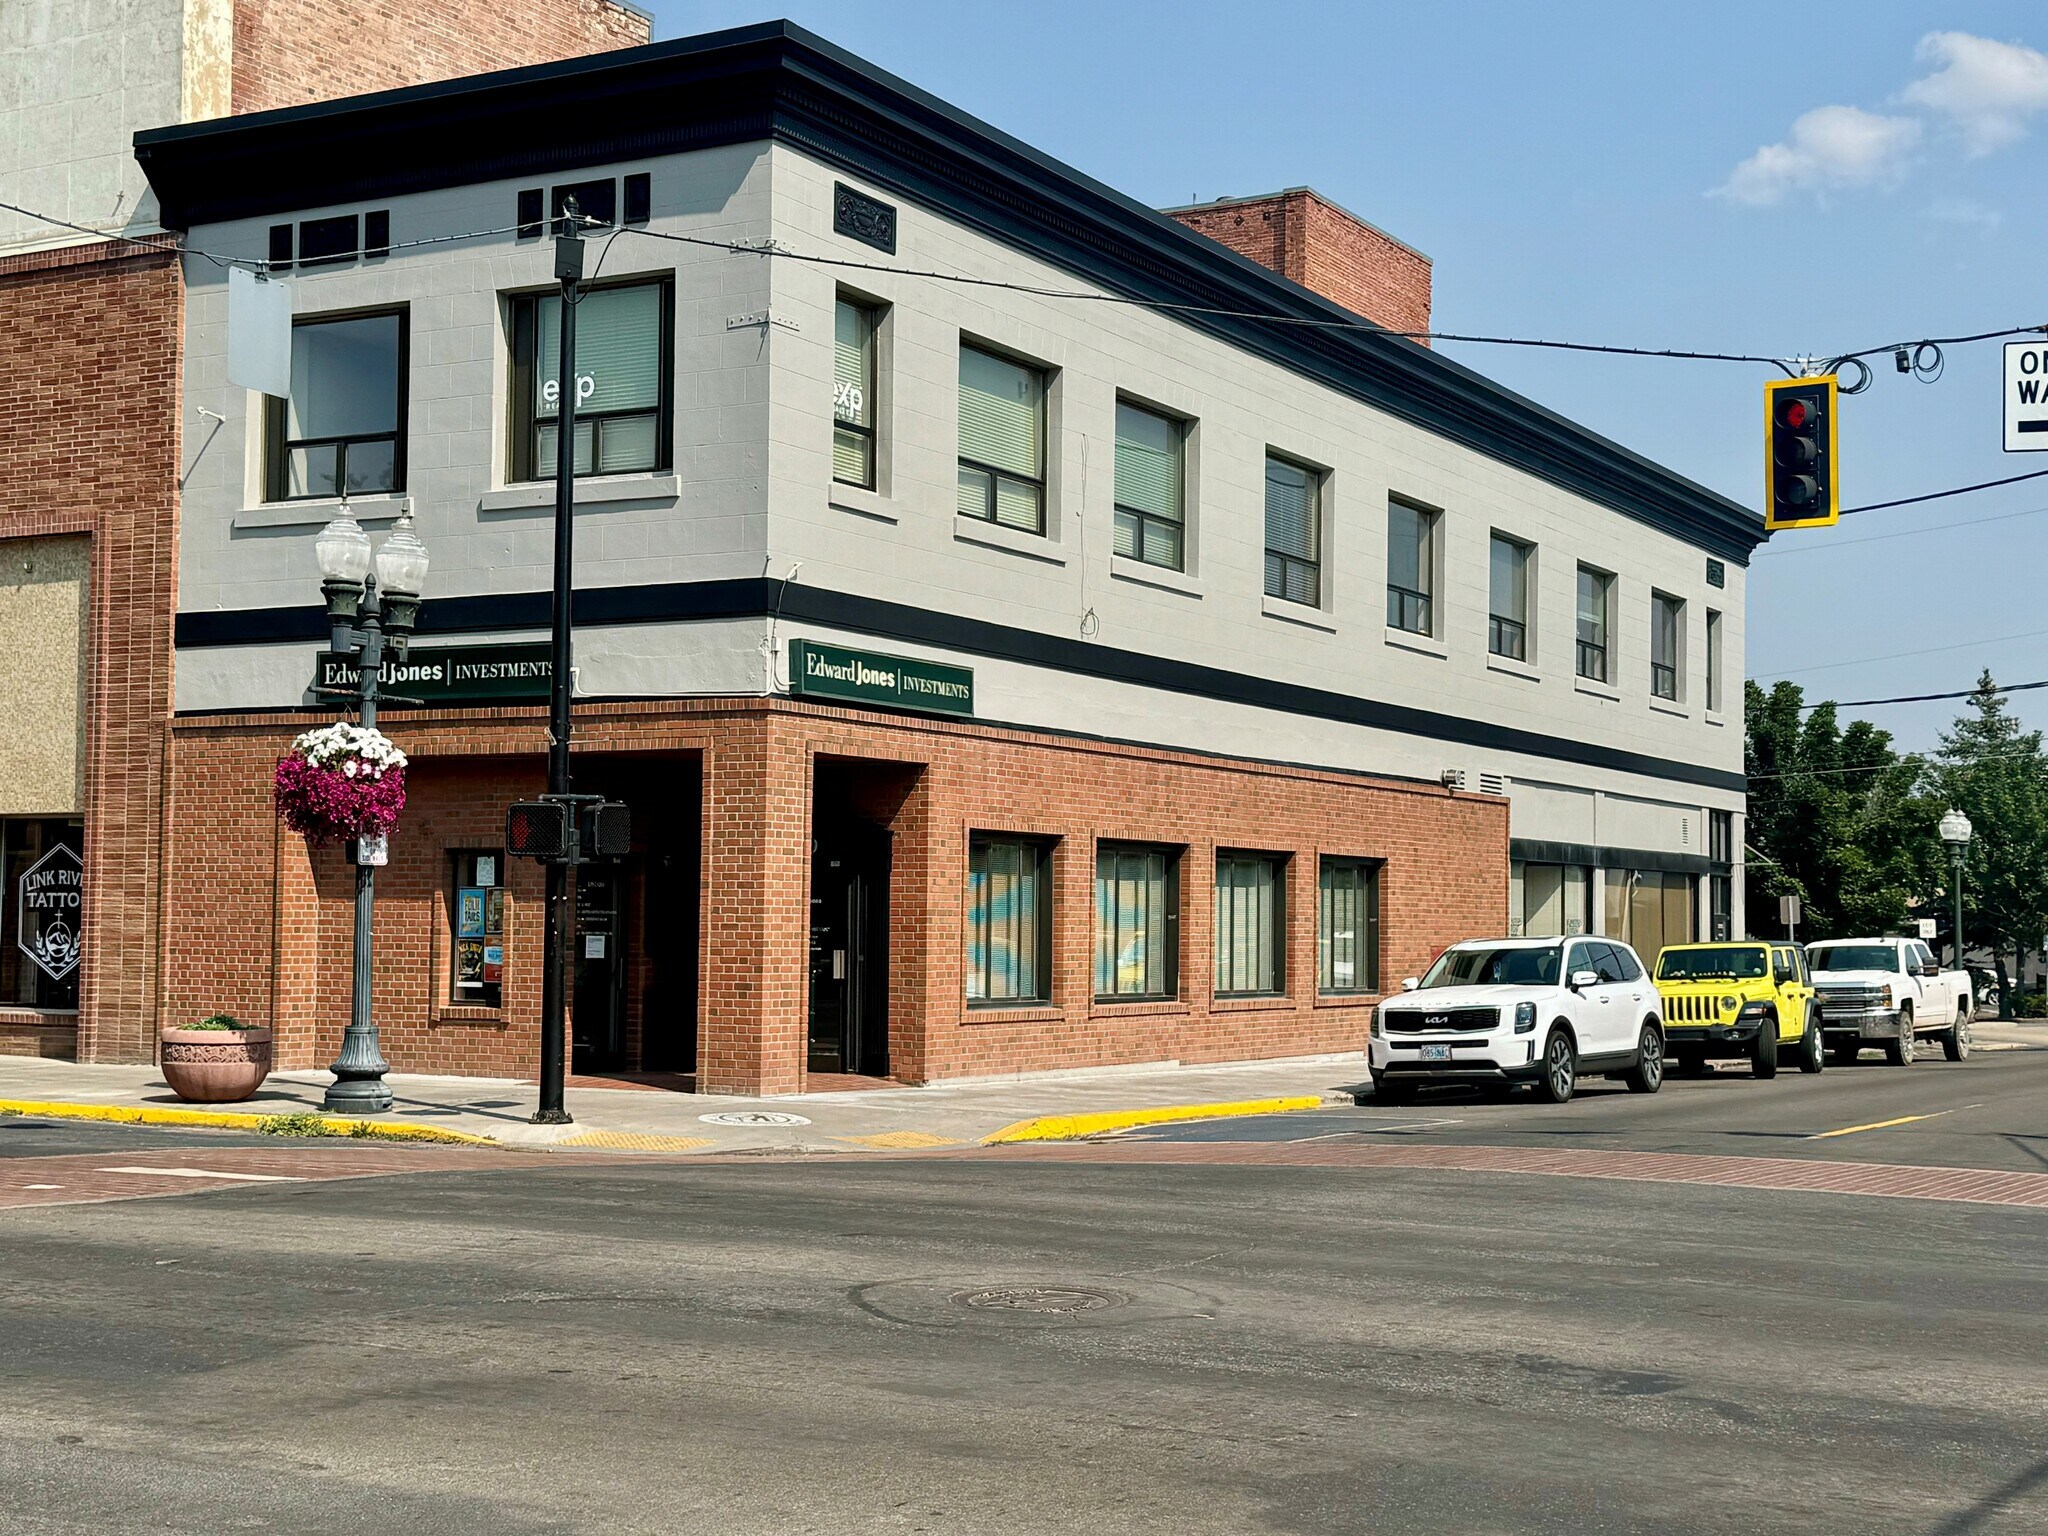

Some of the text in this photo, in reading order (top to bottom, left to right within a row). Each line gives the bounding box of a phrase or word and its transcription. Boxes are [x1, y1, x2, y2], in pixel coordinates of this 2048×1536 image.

[543, 373, 595, 407] ep
[324, 661, 389, 685] Edwd
[388, 662, 443, 685] Jones
[806, 652, 970, 699] Edward Jones INVESTMENTS
[26, 870, 55, 891] LINK
